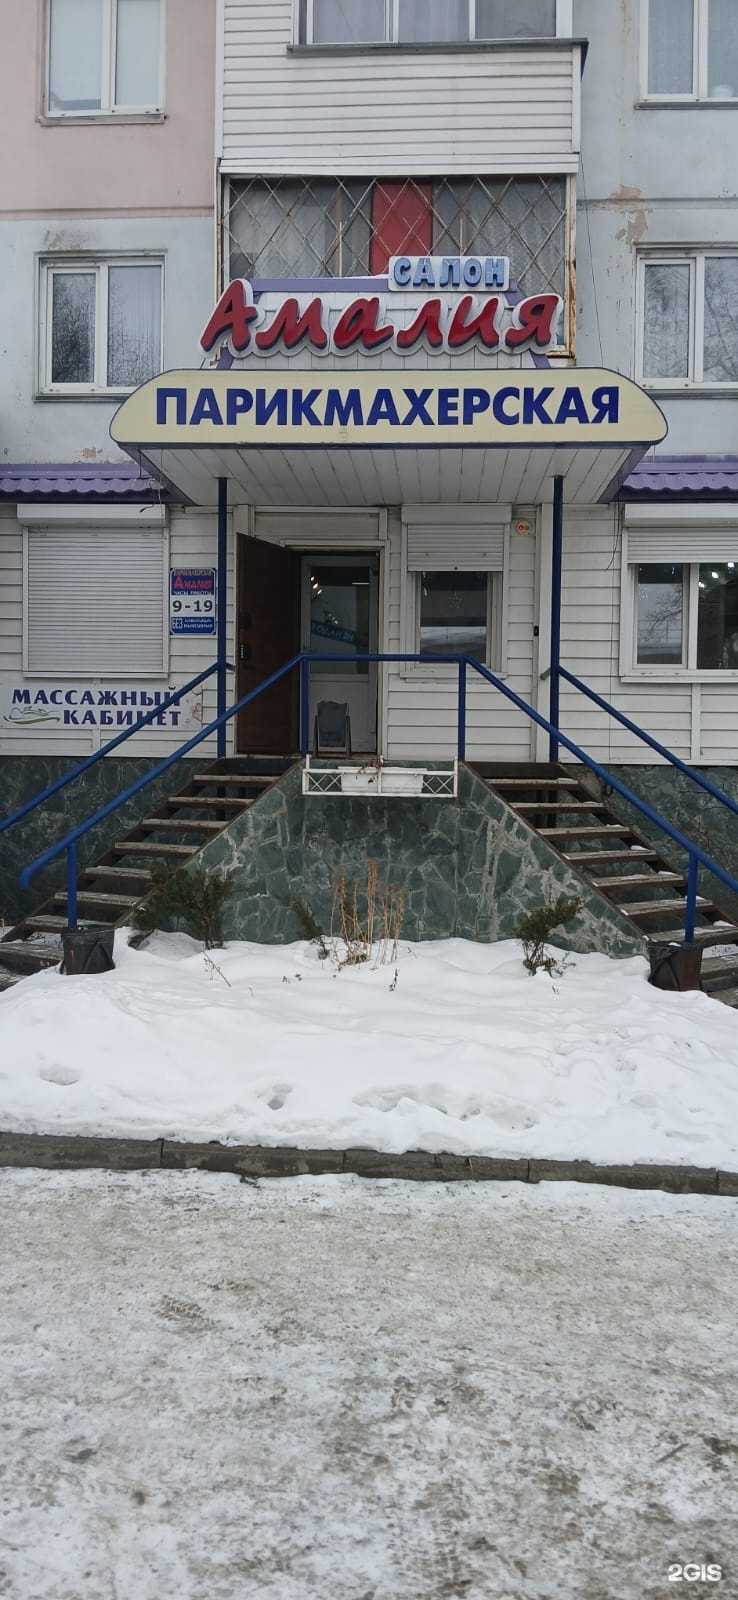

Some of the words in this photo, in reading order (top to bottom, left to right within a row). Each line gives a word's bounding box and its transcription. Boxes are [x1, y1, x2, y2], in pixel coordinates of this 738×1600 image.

[392, 256, 507, 288] САЛОН
[199, 279, 563, 351] Амалия
[155, 387, 620, 426] ПАРИКМАХЕРСКАЯ
